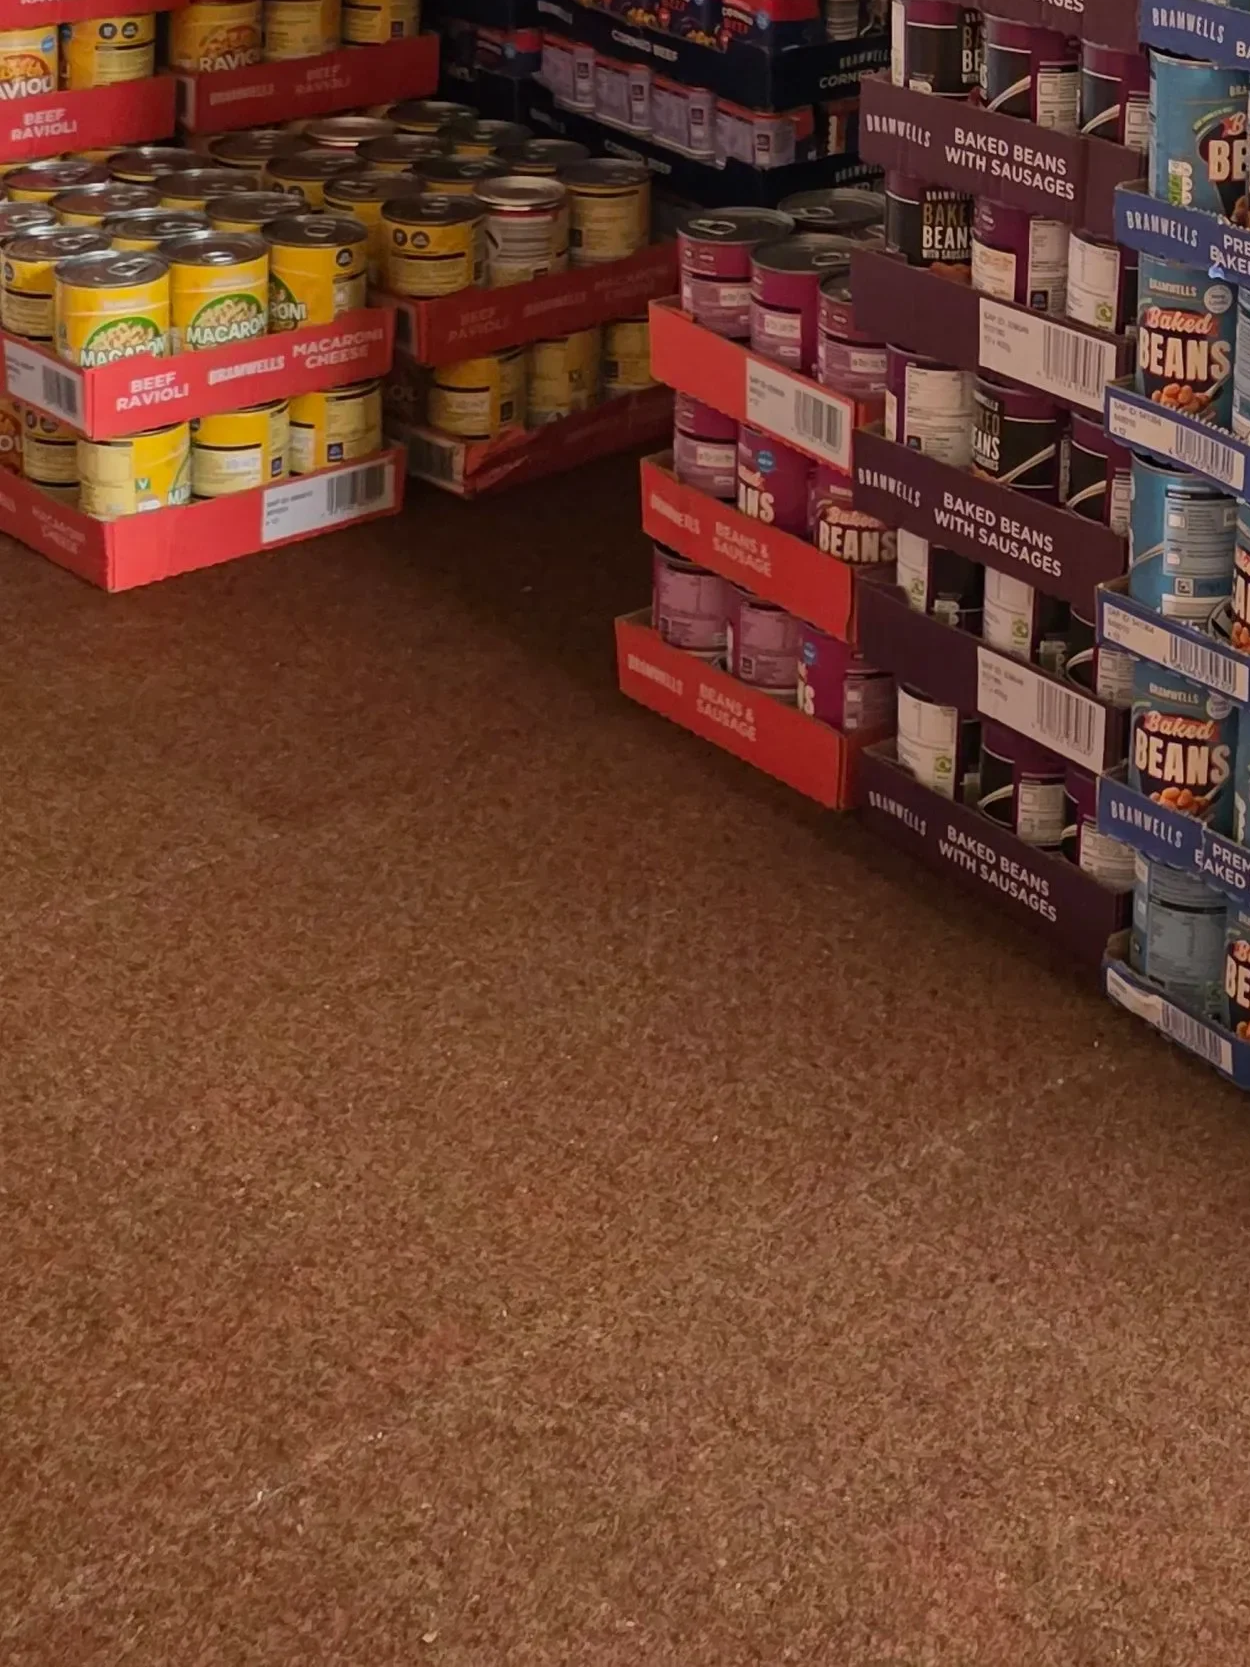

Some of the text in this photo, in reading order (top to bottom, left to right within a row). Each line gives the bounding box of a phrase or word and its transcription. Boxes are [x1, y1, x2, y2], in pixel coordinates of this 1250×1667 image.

[1151, 7, 1225, 44] BRAMWELLS
[866, 114, 931, 147] BRAMWELLS
[954, 128, 1067, 176] BAKED BEANS
[945, 145, 1074, 200] WITH SAUSAGES
[292, 329, 384, 358] MACARONI
[305, 344, 369, 368] CHEESE
[130, 371, 176, 394] BEEF
[208, 356, 285, 386] BRAMWELLS
[116, 383, 189, 411] RAVIOLI
[868, 790, 926, 836] BRAMWELLS
[947, 825, 1050, 896] BAKED BEANS
[939, 840, 1057, 923] WITH SAUSAGES
